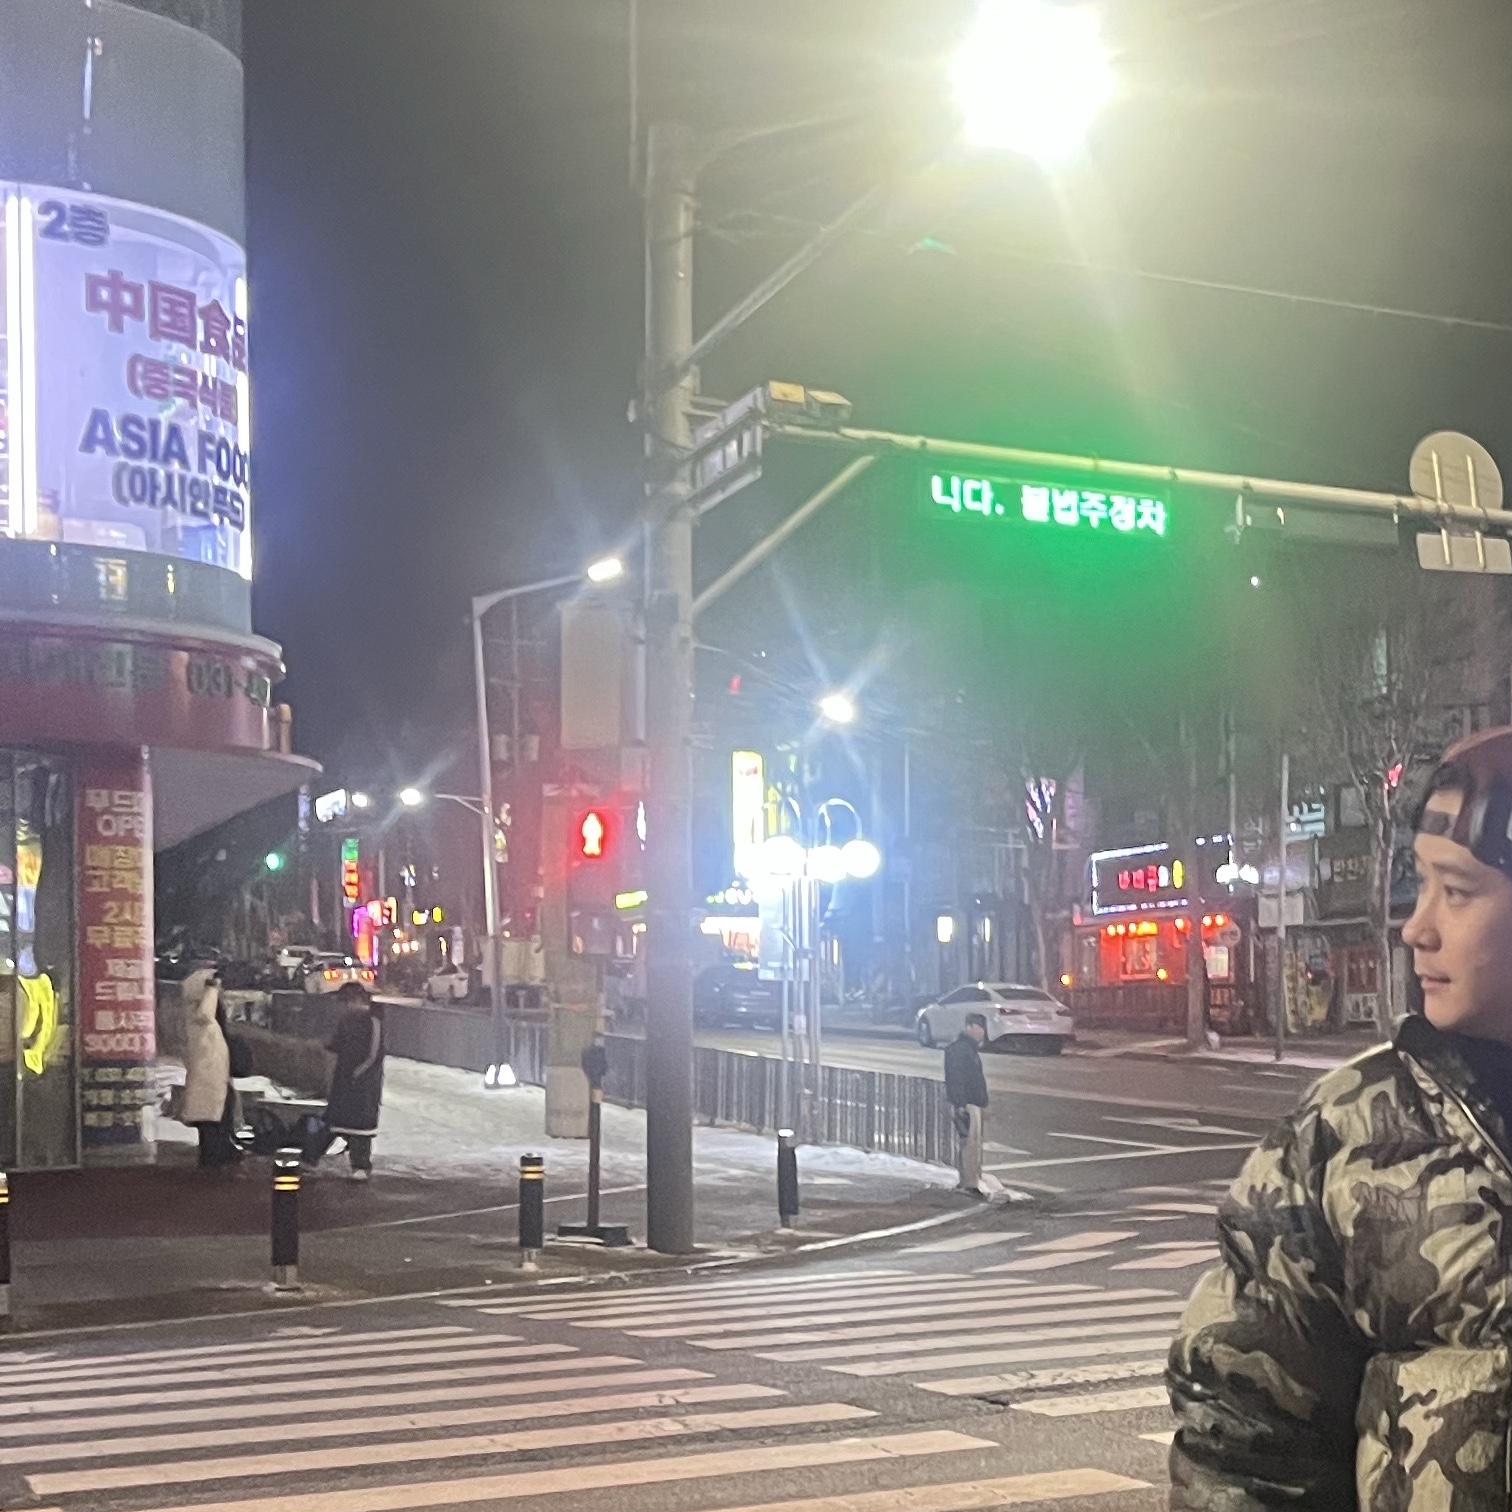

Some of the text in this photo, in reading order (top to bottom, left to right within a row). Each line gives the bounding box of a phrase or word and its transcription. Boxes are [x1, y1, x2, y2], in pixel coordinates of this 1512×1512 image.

[38, 200, 110, 247] 2층
[79, 407, 250, 491] ASIA FOO
[931, 474, 1167, 537] 니다. 불법주정차
